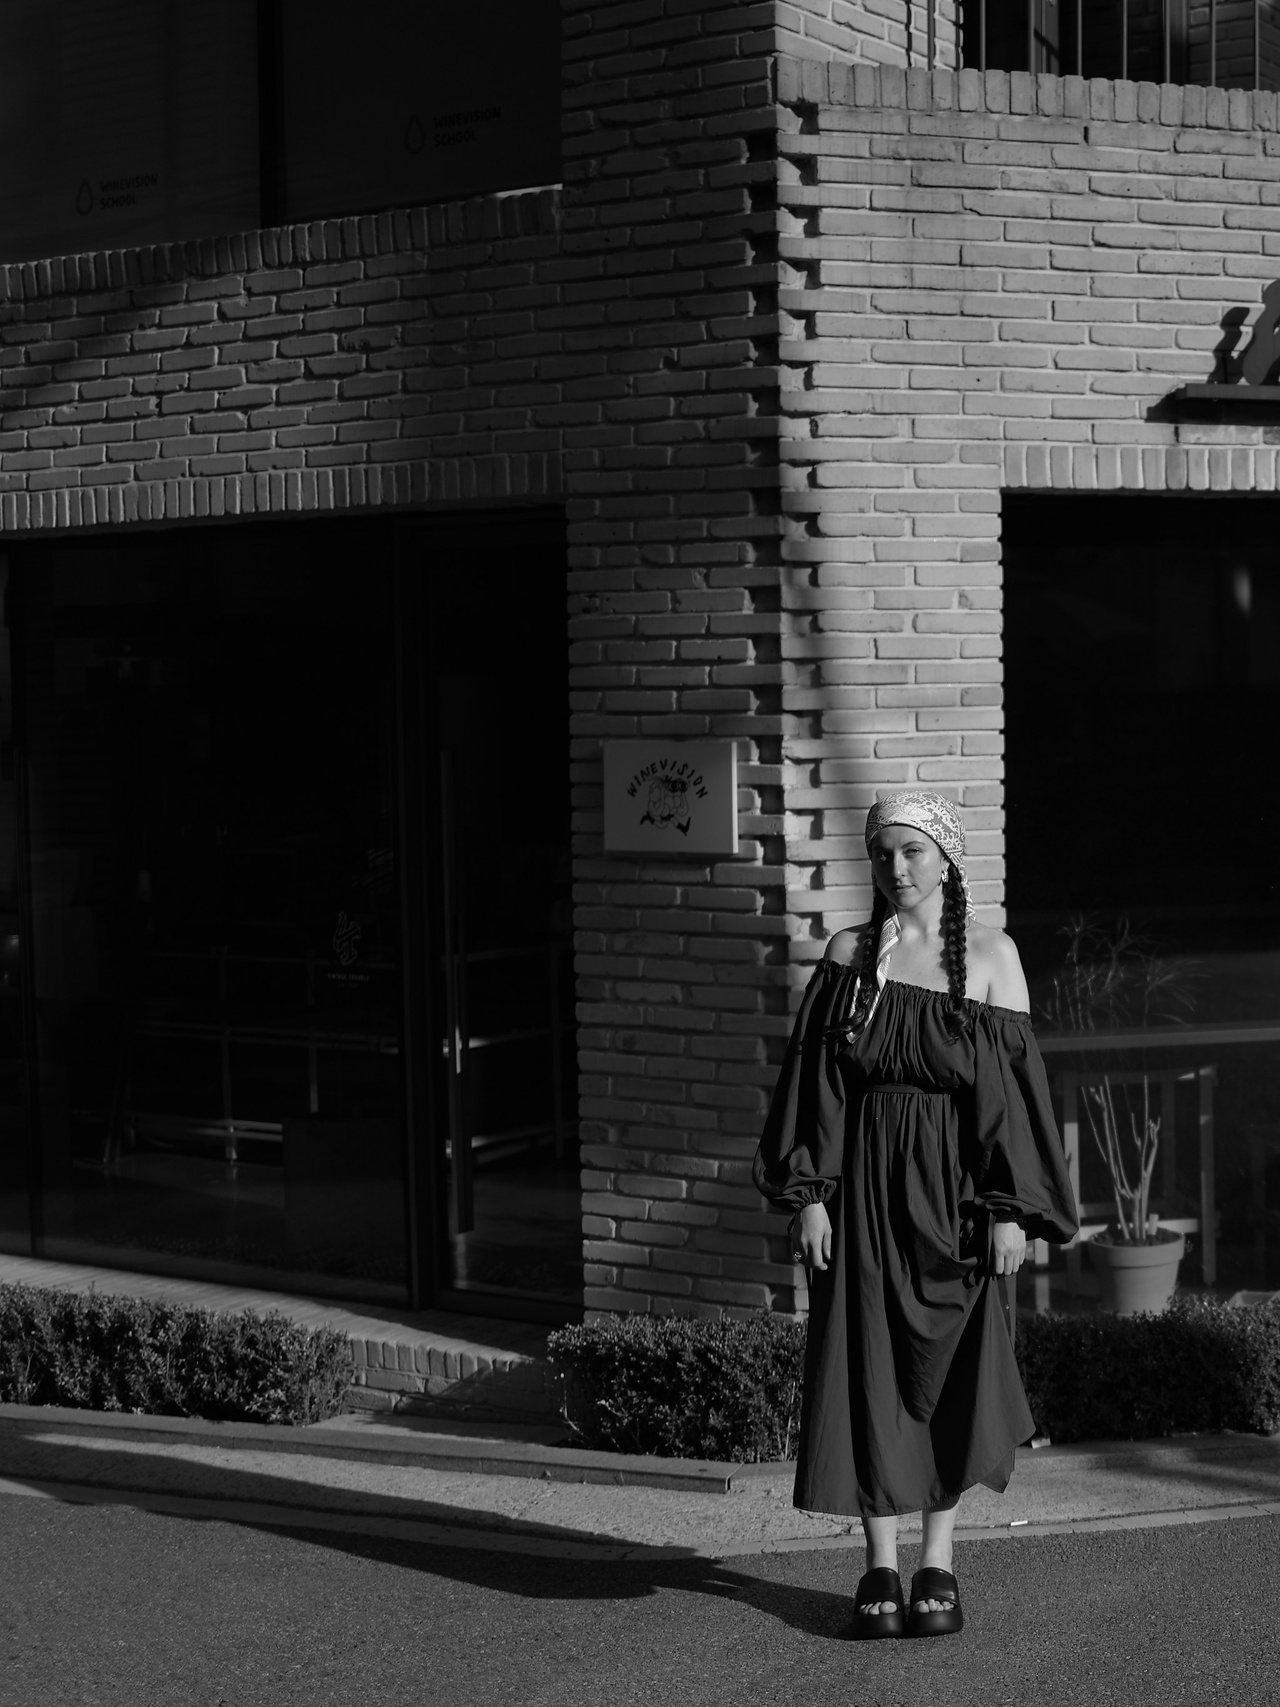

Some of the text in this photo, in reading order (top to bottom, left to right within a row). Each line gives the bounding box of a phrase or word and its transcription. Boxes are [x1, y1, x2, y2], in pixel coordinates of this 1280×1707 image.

[432, 106, 502, 129] WINEVISION
[433, 129, 478, 148] SCHOOL
[99, 173, 159, 193] WINEVISION
[99, 193, 137, 210] SCHOOL
[627, 758, 708, 799] WINEVISION
